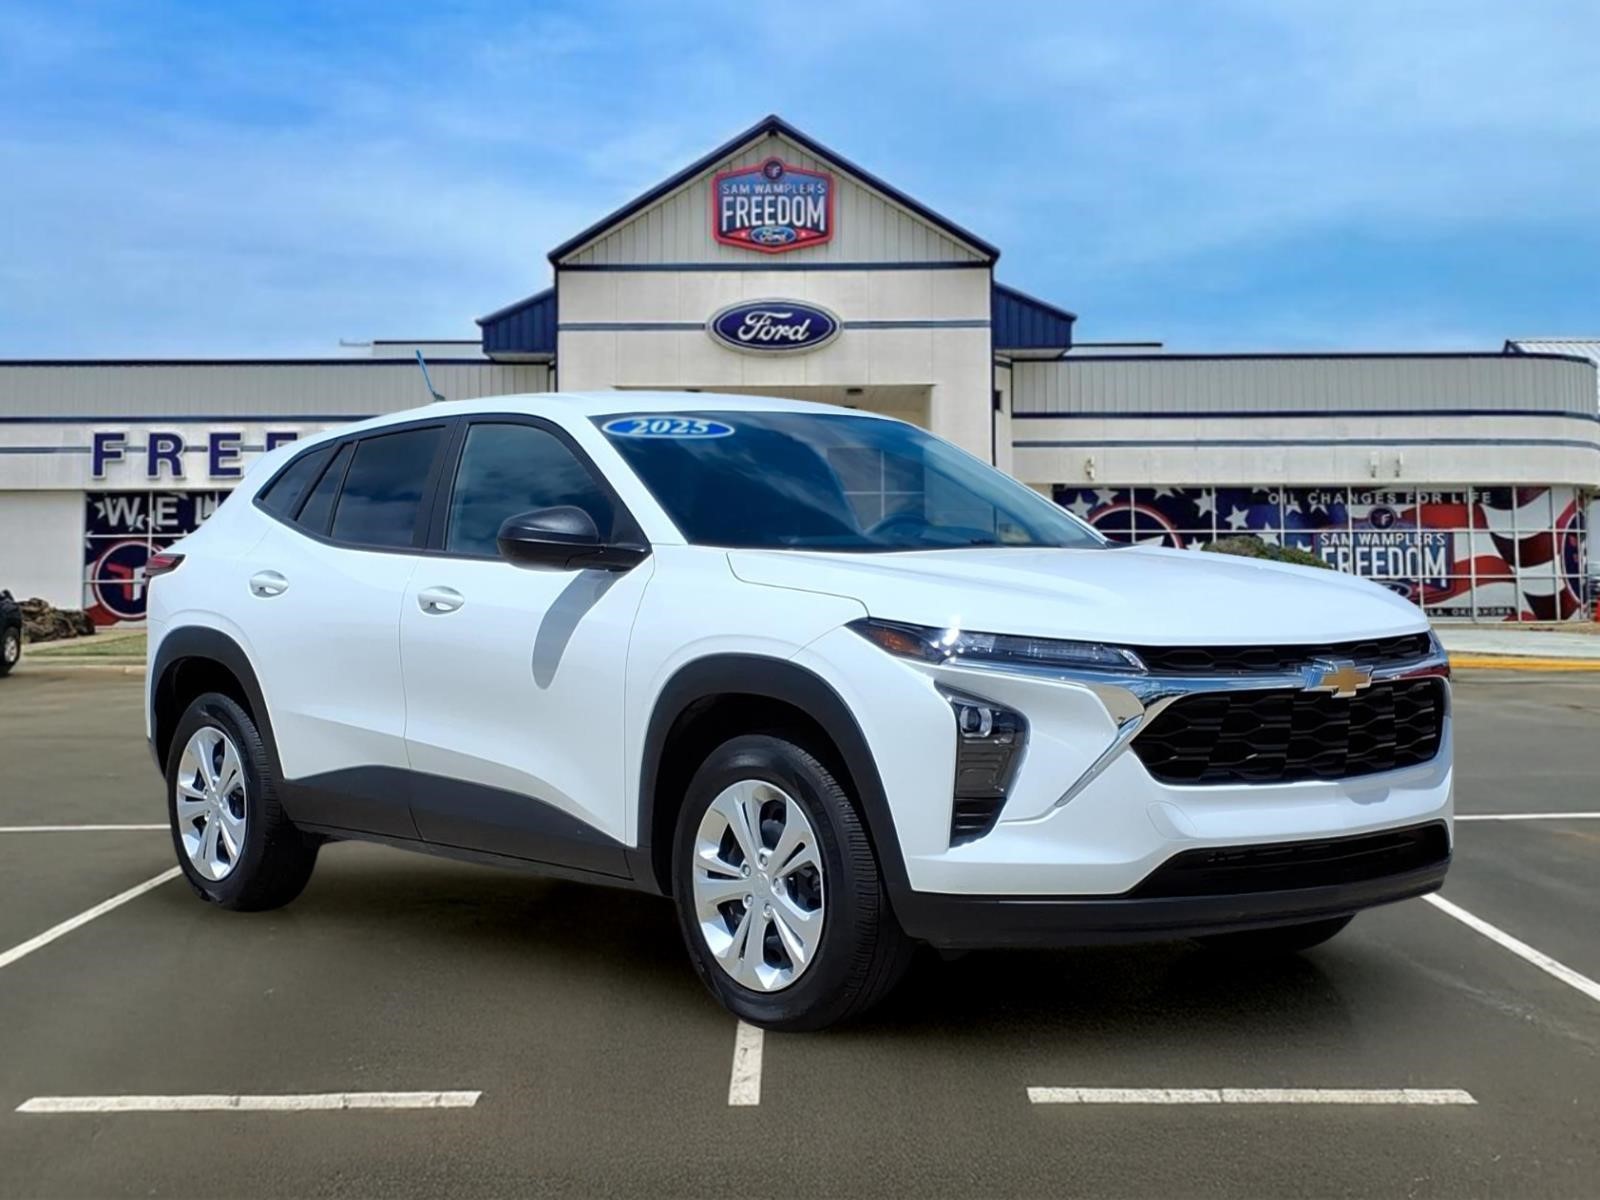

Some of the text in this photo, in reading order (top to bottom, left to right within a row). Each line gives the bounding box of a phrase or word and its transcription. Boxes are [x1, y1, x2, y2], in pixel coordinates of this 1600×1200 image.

[722, 183, 750, 194] SAM
[722, 195, 825, 232] FREEDOM
[738, 311, 811, 341] Ford
[629, 420, 710, 434] 2025
[1268, 492, 1491, 505] OIL CHANGES FOR LIFE
